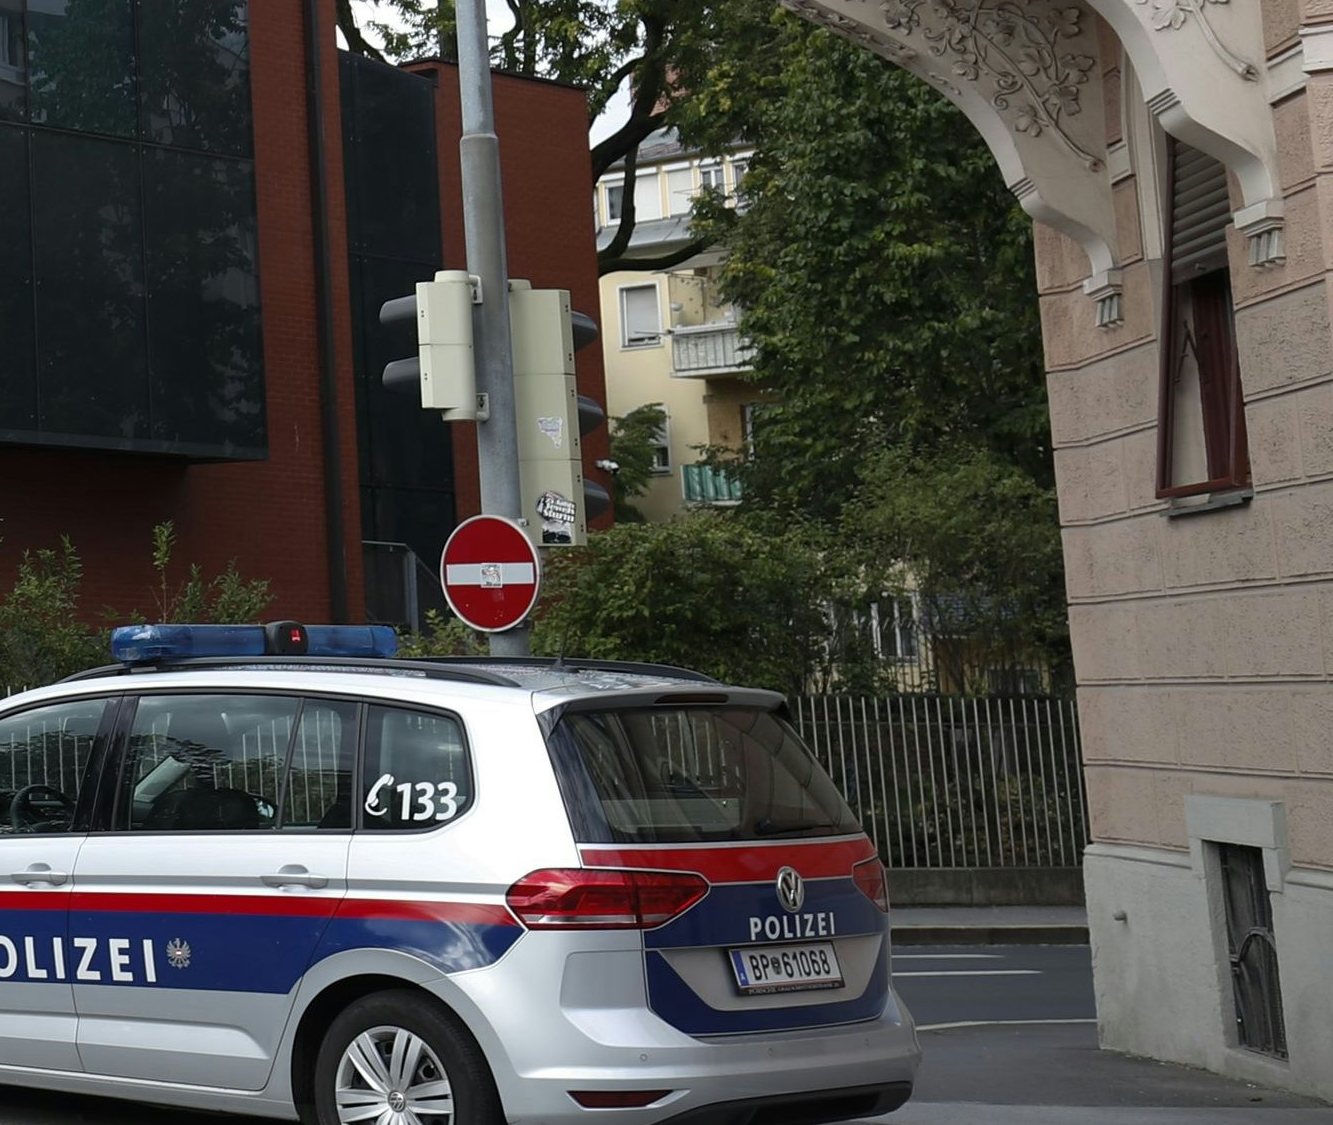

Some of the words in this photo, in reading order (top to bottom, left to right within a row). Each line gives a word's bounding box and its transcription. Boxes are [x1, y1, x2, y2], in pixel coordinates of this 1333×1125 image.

[395, 781, 459, 822] 133
[749, 911, 836, 941] POLIZEI
[749, 954, 771, 981] BP
[781, 949, 831, 979] 61068
